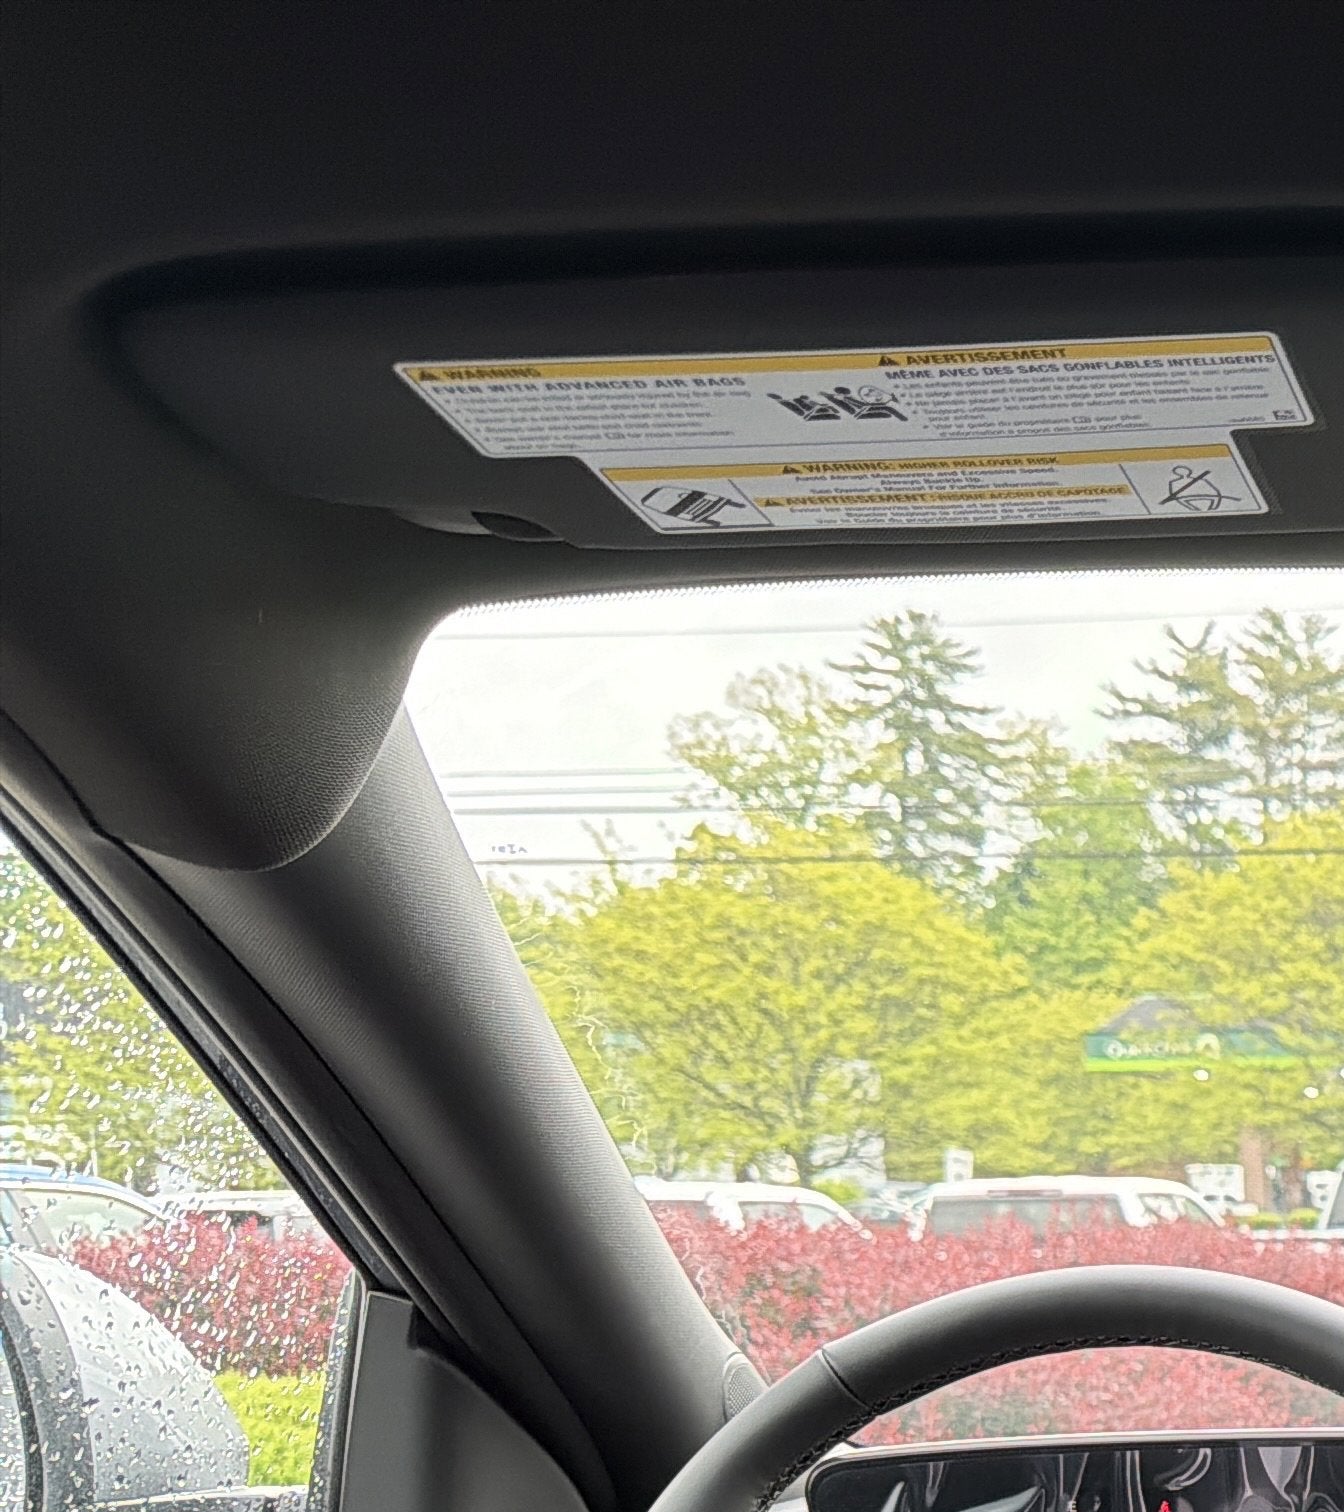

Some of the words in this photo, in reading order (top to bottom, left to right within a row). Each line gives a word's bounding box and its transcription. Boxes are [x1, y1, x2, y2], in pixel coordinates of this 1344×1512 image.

[906, 348, 1066, 365] AVERTISSEMENT
[443, 367, 541, 380] WARNING
[884, 367, 935, 380] MÊME
[938, 366, 979, 378] AVEC
[982, 365, 1014, 376] DES
[1016, 363, 1060, 374] SACS
[1062, 359, 1164, 372] GONFLABLES
[1167, 354, 1276, 368] INTELLIGENTS
[432, 385, 482, 394] EVEN
[487, 383, 538, 392] WITH
[545, 379, 647, 391] ADVANCED
[655, 378, 688, 388] AIR
[692, 376, 746, 387] BAGS
[1026, 456, 1058, 465] RISK
